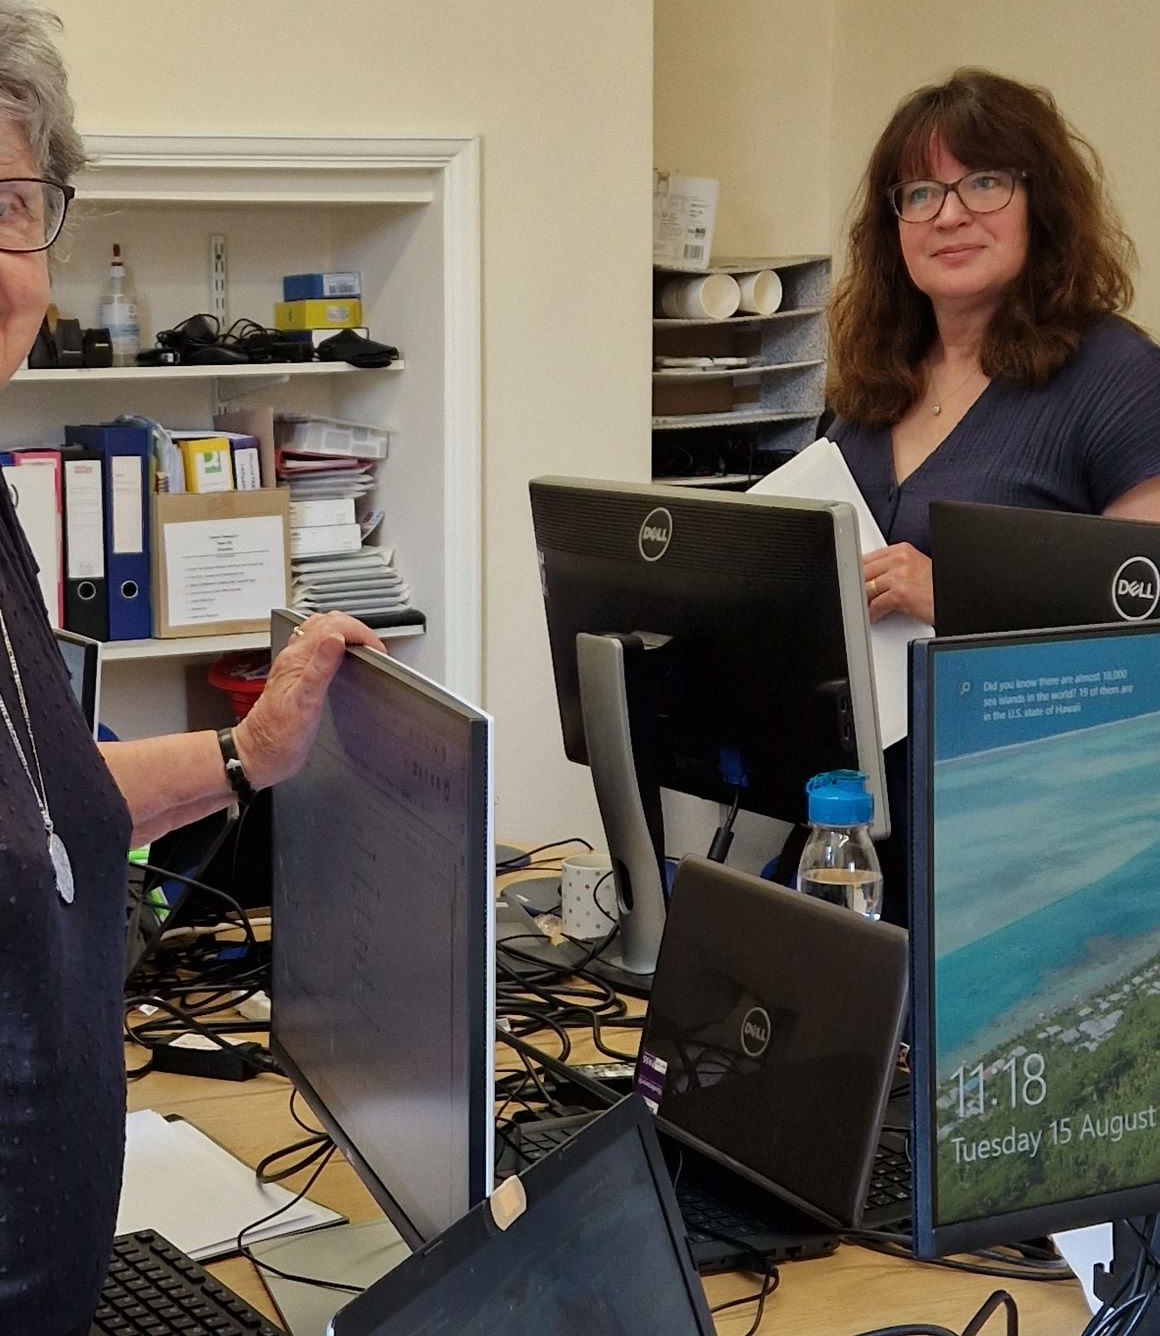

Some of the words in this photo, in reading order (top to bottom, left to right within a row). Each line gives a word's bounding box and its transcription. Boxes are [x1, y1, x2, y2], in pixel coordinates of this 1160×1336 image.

[643, 526, 668, 542] DELL
[1118, 579, 1155, 599] DELL
[983, 680, 998, 692] Did
[999, 681, 1015, 693] you
[1015, 679, 1038, 689] know
[1038, 677, 1060, 687] there
[1060, 675, 1074, 685] are
[1074, 672, 1101, 684] almost
[983, 697, 998, 708] sea
[998, 694, 1026, 705] islands
[1026, 692, 1036, 703] in
[1036, 692, 1050, 702] the
[1050, 688, 1077, 701] world?
[1079, 686, 1089, 698] 19
[1089, 685, 1099, 697] of
[1099, 684, 1120, 696] them
[1120, 684, 1134, 694] are
[983, 712, 992, 722] in
[992, 710, 1007, 721] the
[1007, 708, 1024, 719] U.S.
[1024, 707, 1044, 718] state
[1044, 705, 1055, 716] of
[744, 1021, 766, 1042] DELL
[949, 1052, 1047, 1118] 11:18
[951, 1126, 1042, 1164] Tuesday
[1049, 1117, 1073, 1145] 15
[1079, 1104, 1156, 1143] August
